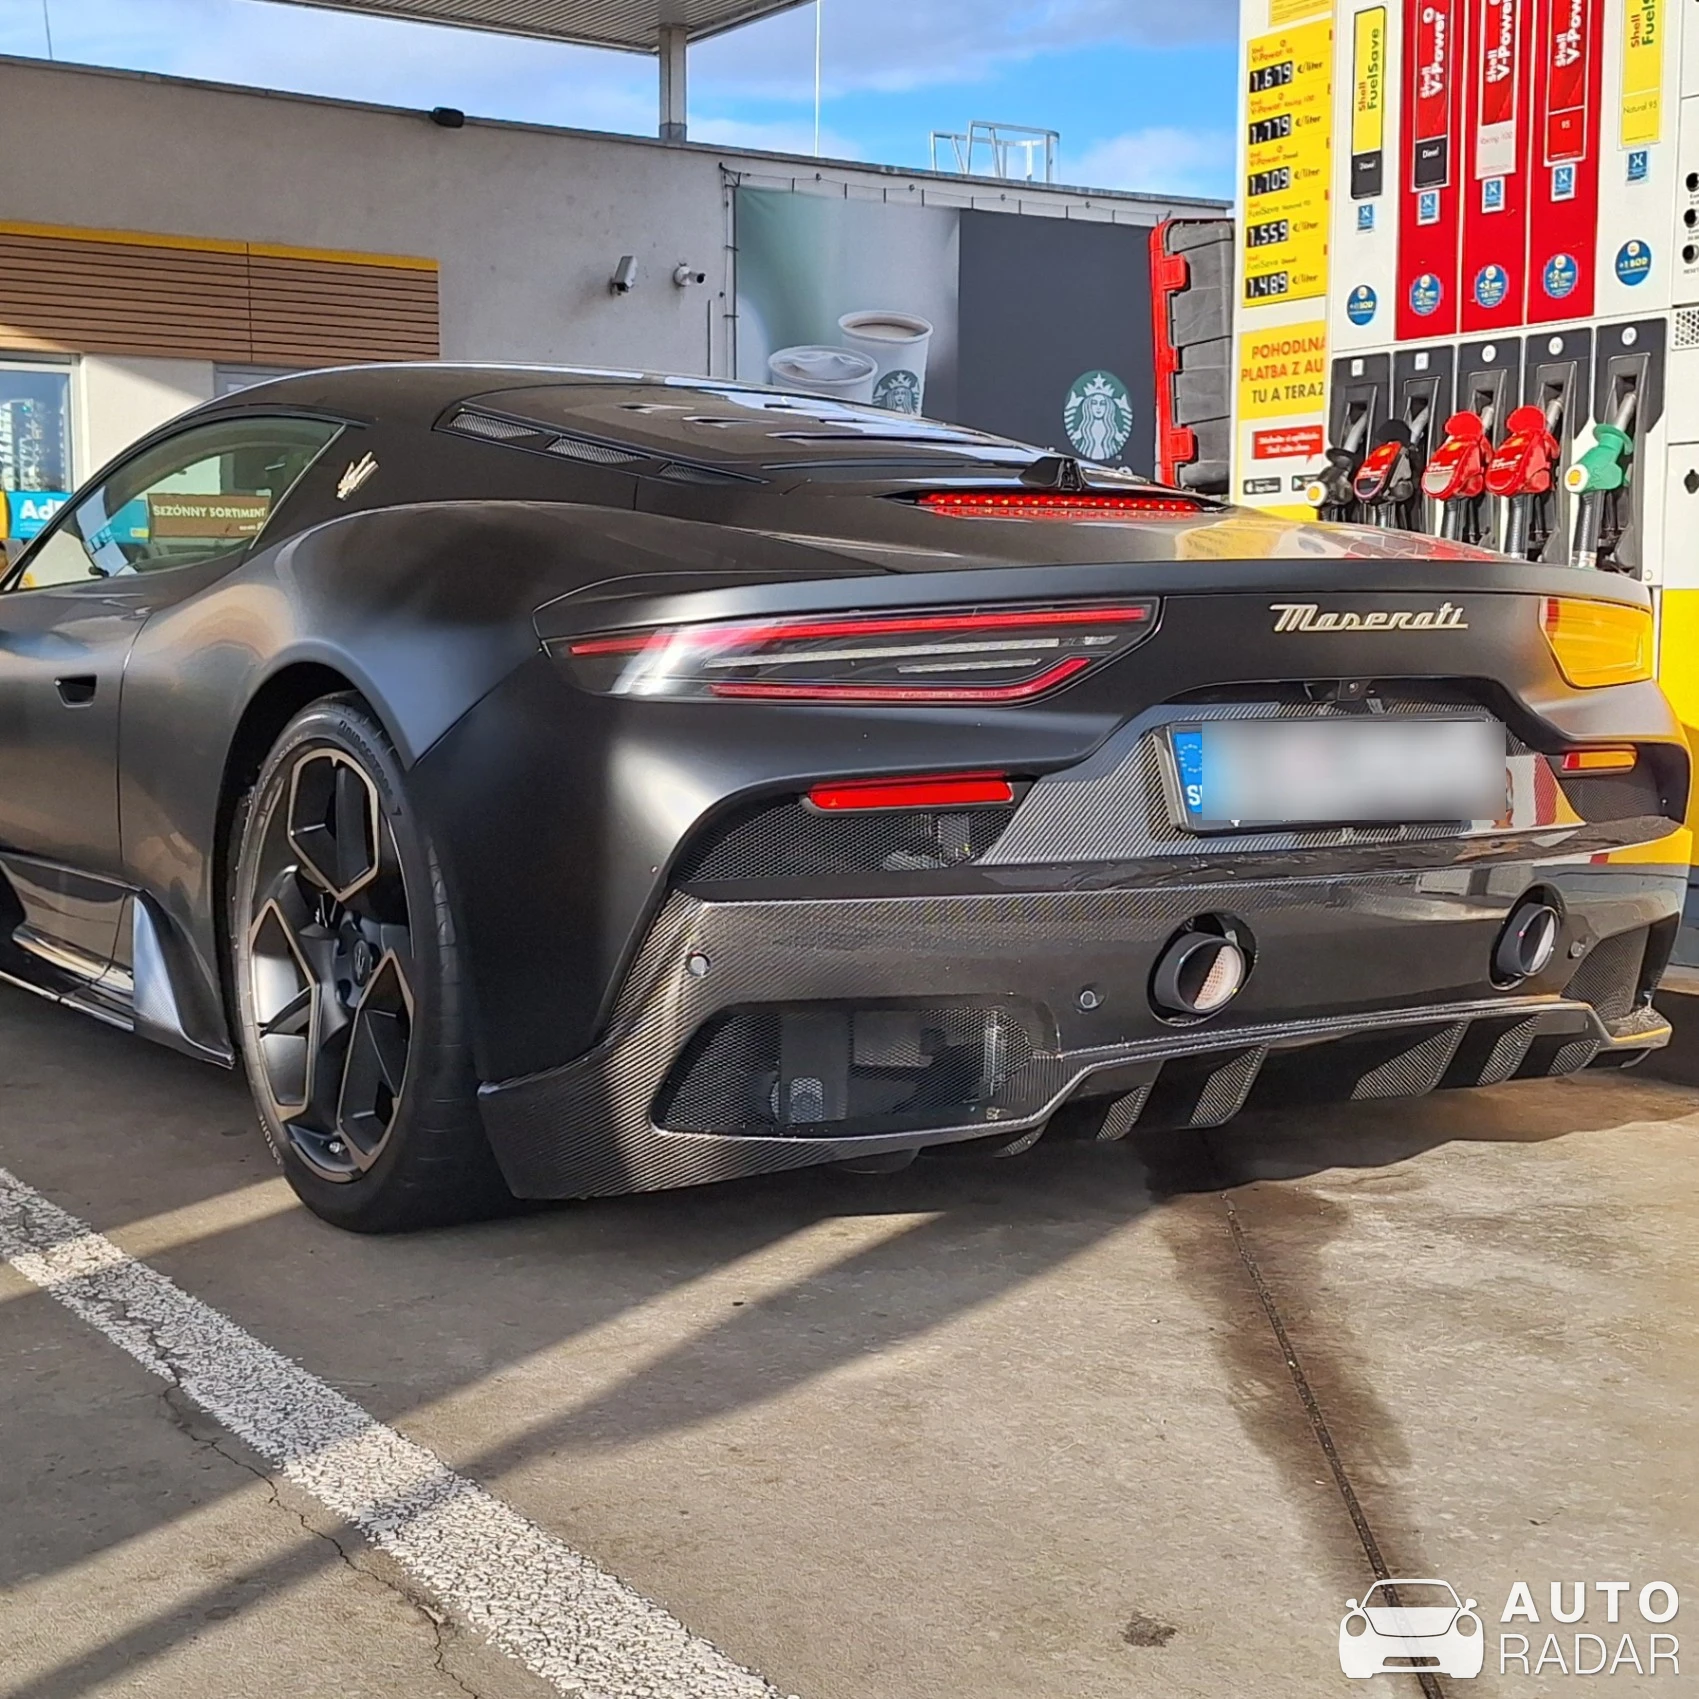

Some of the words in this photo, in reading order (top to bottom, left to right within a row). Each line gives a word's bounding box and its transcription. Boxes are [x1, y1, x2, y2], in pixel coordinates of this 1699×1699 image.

[1496, 0, 1512, 81] V-Powe
[1630, 13, 1641, 48] Shell
[1430, 11, 1445, 96] V-Power
[1554, 32, 1568, 67] Shell
[1252, 63, 1292, 91] 1.679
[1367, 28, 1380, 110] FuelSave
[1486, 48, 1499, 83] Shell
[1358, 81, 1367, 112] Shell
[1420, 66, 1432, 98] Shell
[1251, 115, 1290, 144] 1.779
[1422, 145, 1440, 159] Diesel
[1250, 168, 1289, 195] 1.709
[1249, 221, 1288, 247] 1.559
[1248, 272, 1288, 298] 1.489
[1241, 363, 1288, 382] PLATBA
[1291, 361, 1300, 376] Z
[1252, 388, 1268, 404] TU
[1270, 387, 1281, 402] A
[153, 504, 207, 518] SEZÓNNY
[208, 506, 266, 519] SORTIMENT
[1269, 602, 1469, 632] Maserati
